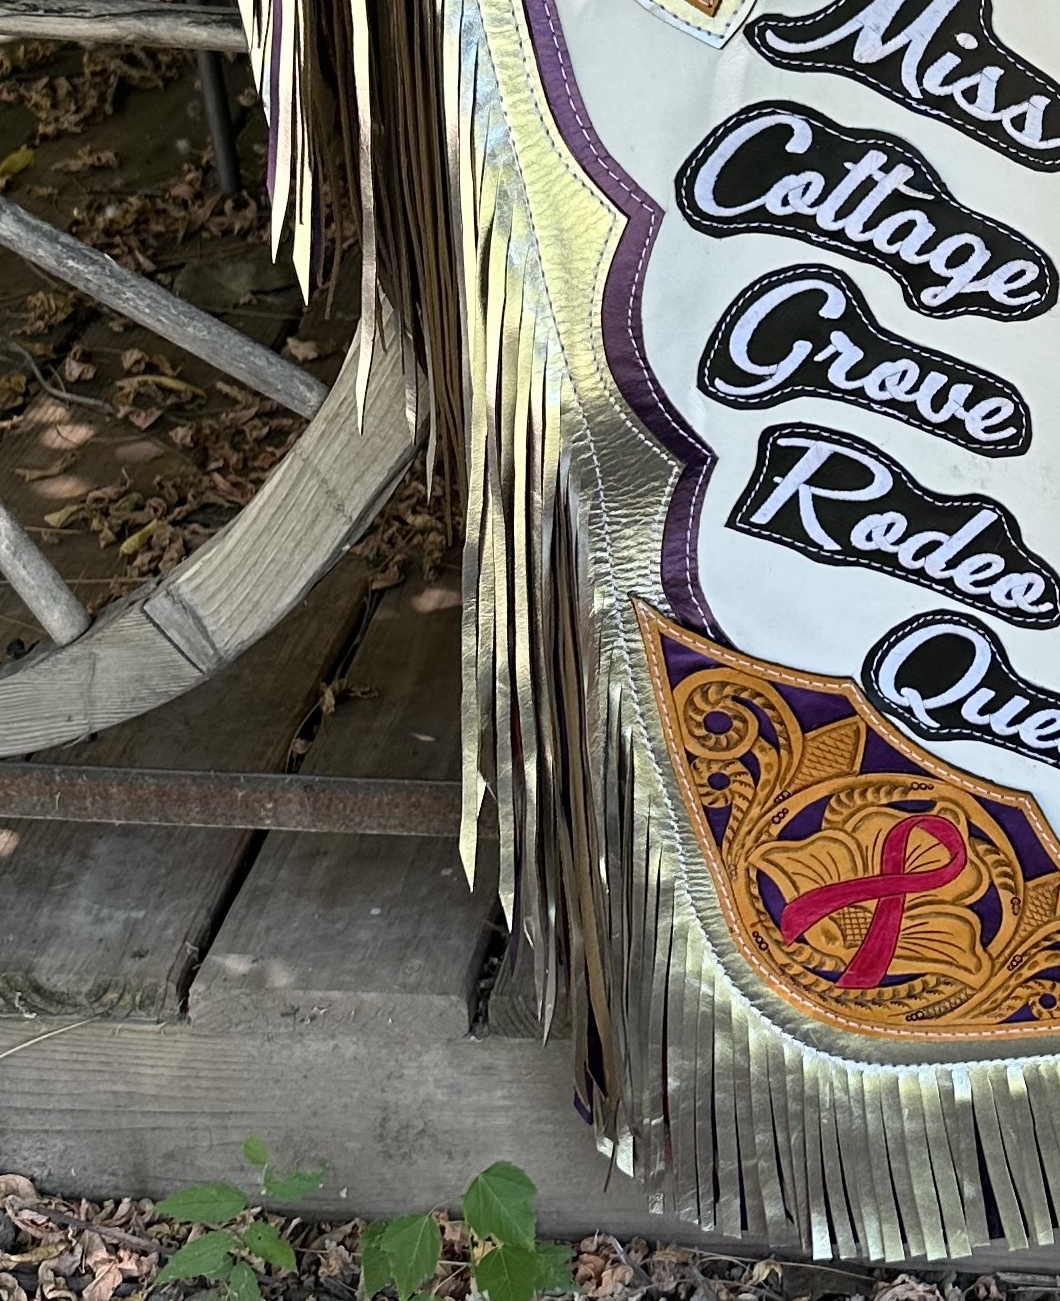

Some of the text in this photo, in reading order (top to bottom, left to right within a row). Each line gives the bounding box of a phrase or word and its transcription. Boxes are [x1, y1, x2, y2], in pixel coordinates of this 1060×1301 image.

[694, 114, 1041, 306] Cottage
[714, 279, 1017, 441] Grove
[750, 437, 1054, 614] Rodeo
